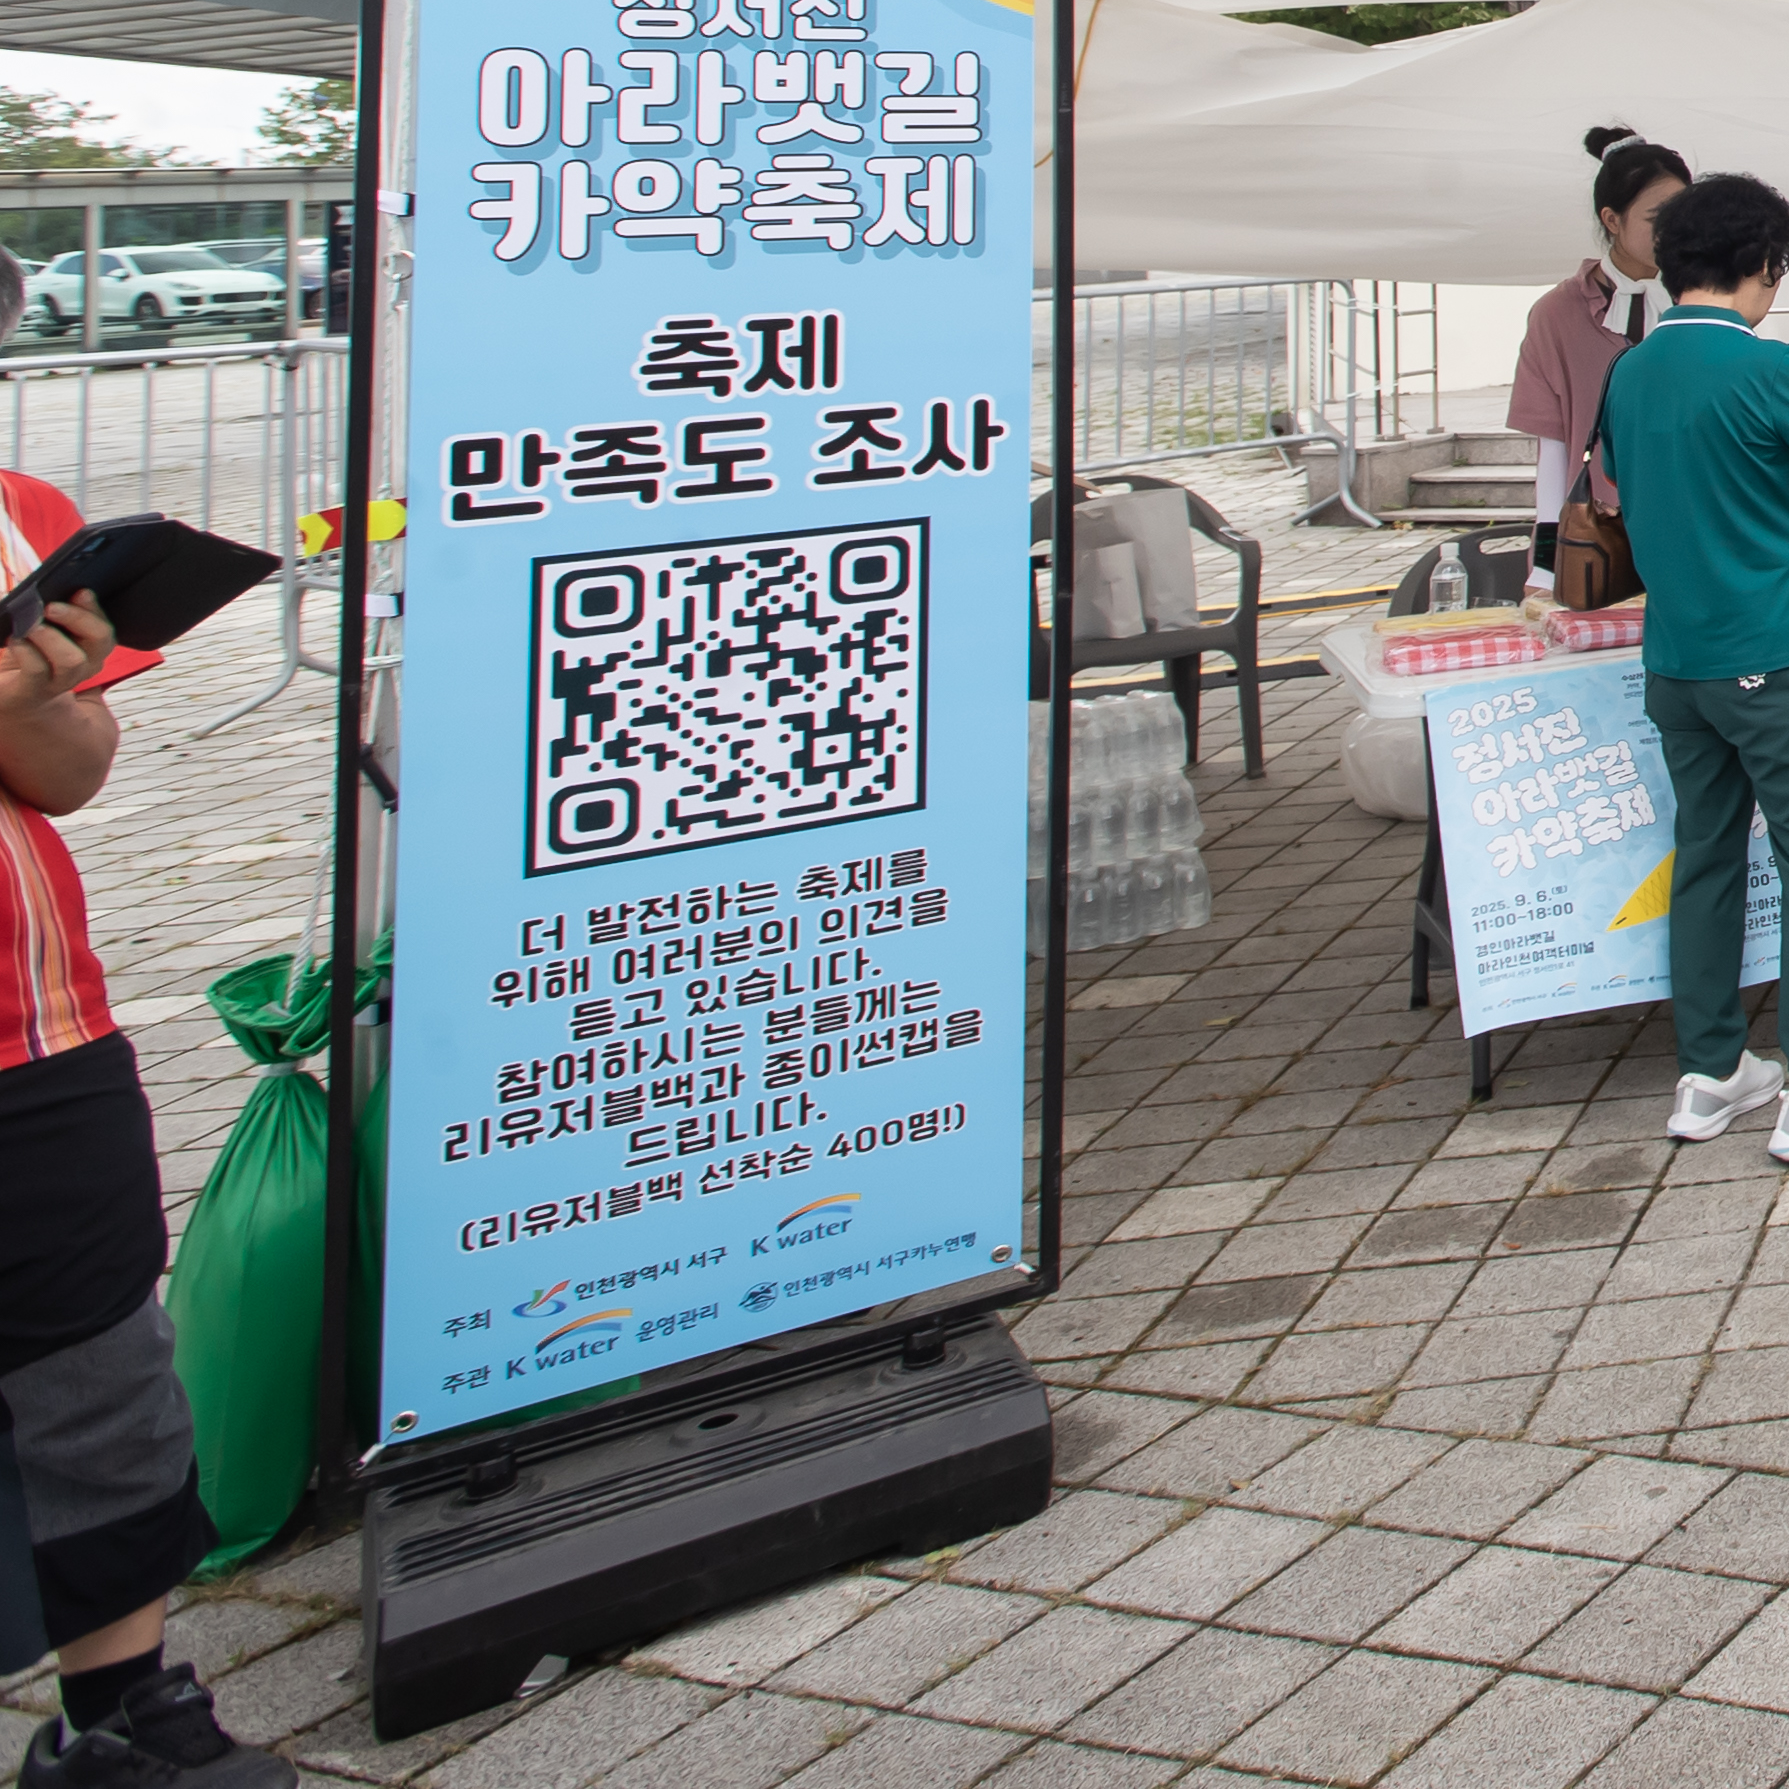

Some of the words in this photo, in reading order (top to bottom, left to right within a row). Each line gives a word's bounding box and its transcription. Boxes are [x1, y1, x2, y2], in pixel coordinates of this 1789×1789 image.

[478, 47, 982, 149] 아라뱃길
[469, 153, 979, 261] 카약축제
[639, 312, 839, 396] 축제
[449, 416, 774, 523] 만족도
[814, 399, 1004, 485] 조사
[1448, 686, 1538, 737] 2025
[1452, 707, 1587, 784] 정서진
[1472, 740, 1639, 826] 아라뱃길
[1486, 783, 1656, 877] 카약축제
[520, 912, 566, 957] 더
[588, 879, 780, 946] 발전하는
[795, 846, 929, 902] 축제를
[1471, 901, 1511, 917] 2025.
[1514, 894, 1531, 907] 9.
[1472, 902, 1574, 934] 11:00~18:00
[1475, 930, 1556, 957] 경인아라뱃길
[490, 954, 591, 1010] 위해
[612, 915, 800, 986] 여러분의
[817, 886, 950, 948] 의견을
[1478, 941, 1595, 975] 아라인천여객터미널
[568, 987, 668, 1044] 듣고
[685, 948, 883, 1021] 있습니다.
[495, 1021, 746, 1104] 참여하시는
[763, 978, 943, 1046] 분들께는
[442, 1061, 746, 1164] 리유저블백과
[762, 1008, 984, 1093] 종이썬캡을
[622, 1090, 828, 1168] 드립니다.
[459, 1170, 683, 1253] (리유저블백
[698, 1140, 814, 1196] 선착순
[827, 1102, 969, 1159] 400명!)
[750, 1233, 770, 1258] K
[776, 1216, 852, 1256] water
[783, 1260, 871, 1298] 인천광역시
[876, 1232, 977, 1271] 서구카누연맹
[443, 1308, 492, 1338] 주최
[575, 1257, 681, 1302] 인천광역시
[687, 1244, 729, 1272] 서구
[442, 1364, 491, 1394] 주관
[505, 1356, 528, 1381] K
[536, 1334, 620, 1373] water
[636, 1302, 720, 1342] 운영관리
